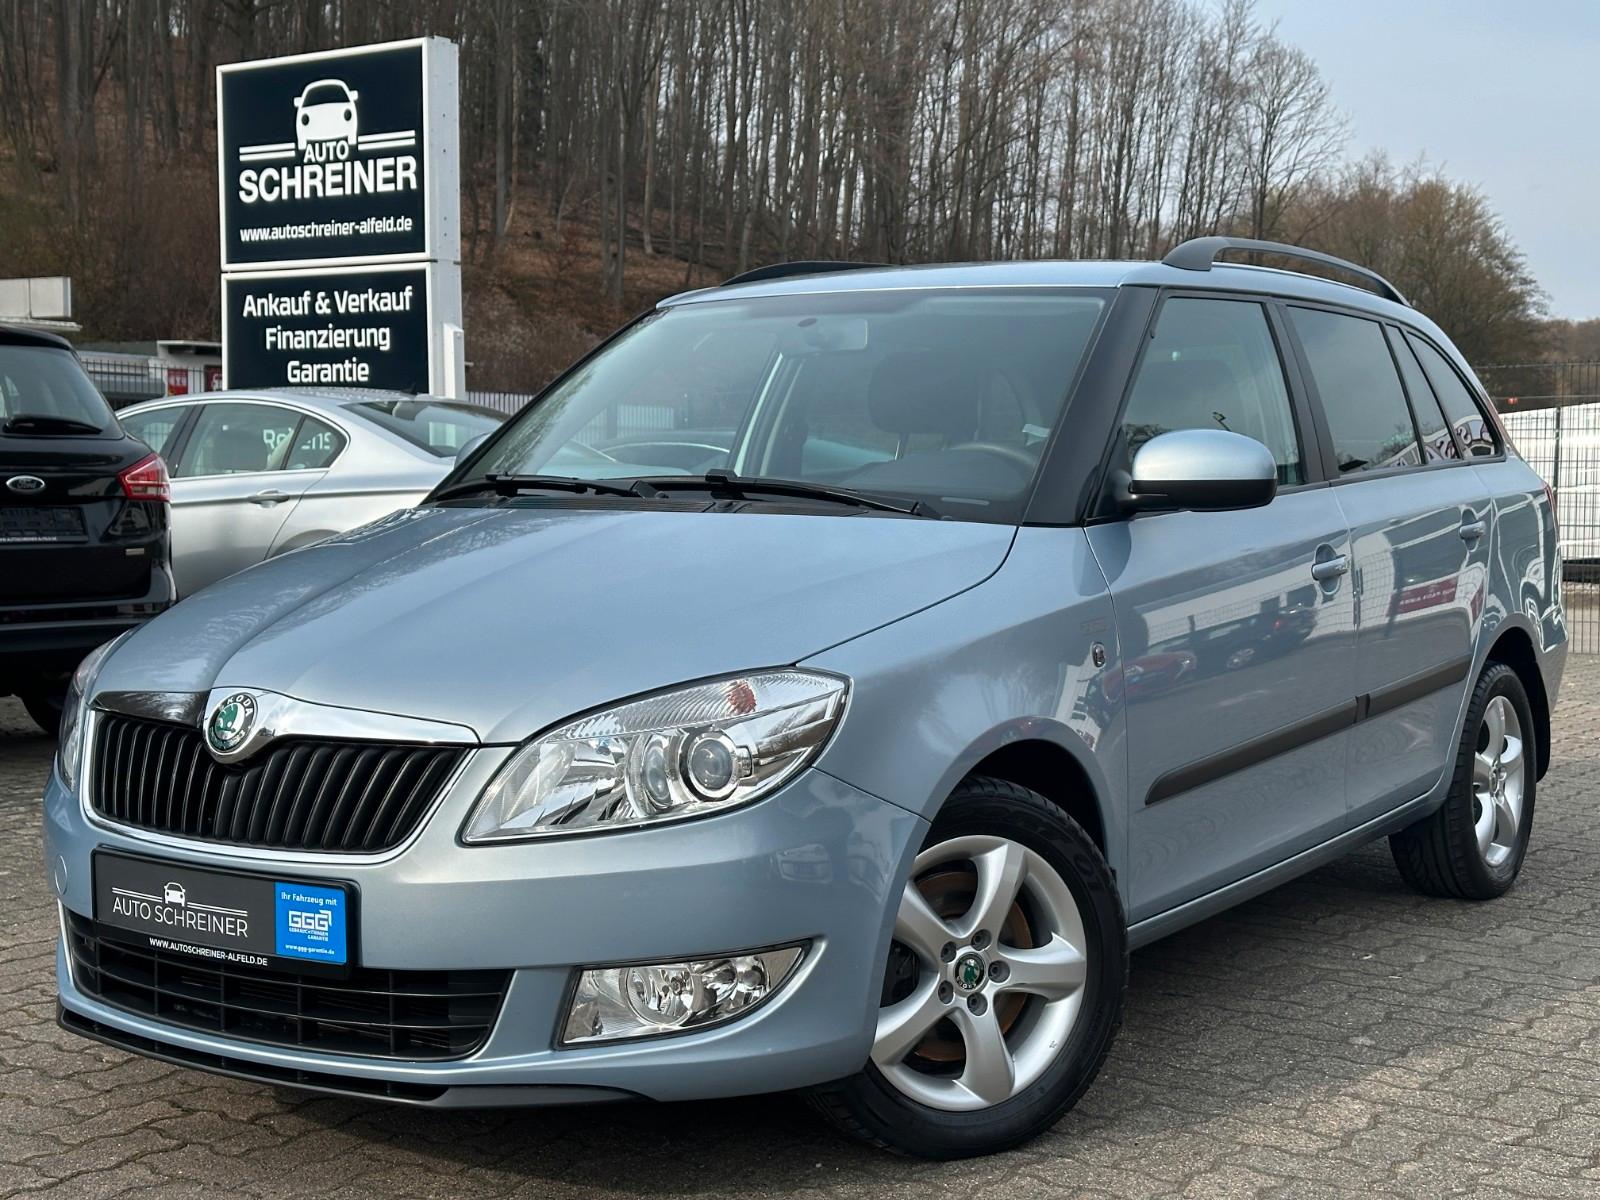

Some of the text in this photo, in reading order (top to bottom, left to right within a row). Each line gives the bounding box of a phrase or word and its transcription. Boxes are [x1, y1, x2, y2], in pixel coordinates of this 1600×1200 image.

[304, 139, 349, 163] AUTO
[239, 156, 417, 203] SCHREINER
[240, 216, 412, 242] www.autoschreiner-alfeld.de
[243, 286, 413, 318] Ankauf & Verkauf
[265, 323, 390, 351] Finanzierung
[287, 357, 369, 383] Garantie
[281, 891, 337, 906] Ihr Fahrzeug mit
[112, 897, 248, 938] AUTO SCHREINER
[288, 909, 330, 932] GGG
[149, 937, 268, 966] WWW.AUTOSCHREINER-ALFELD.DE
